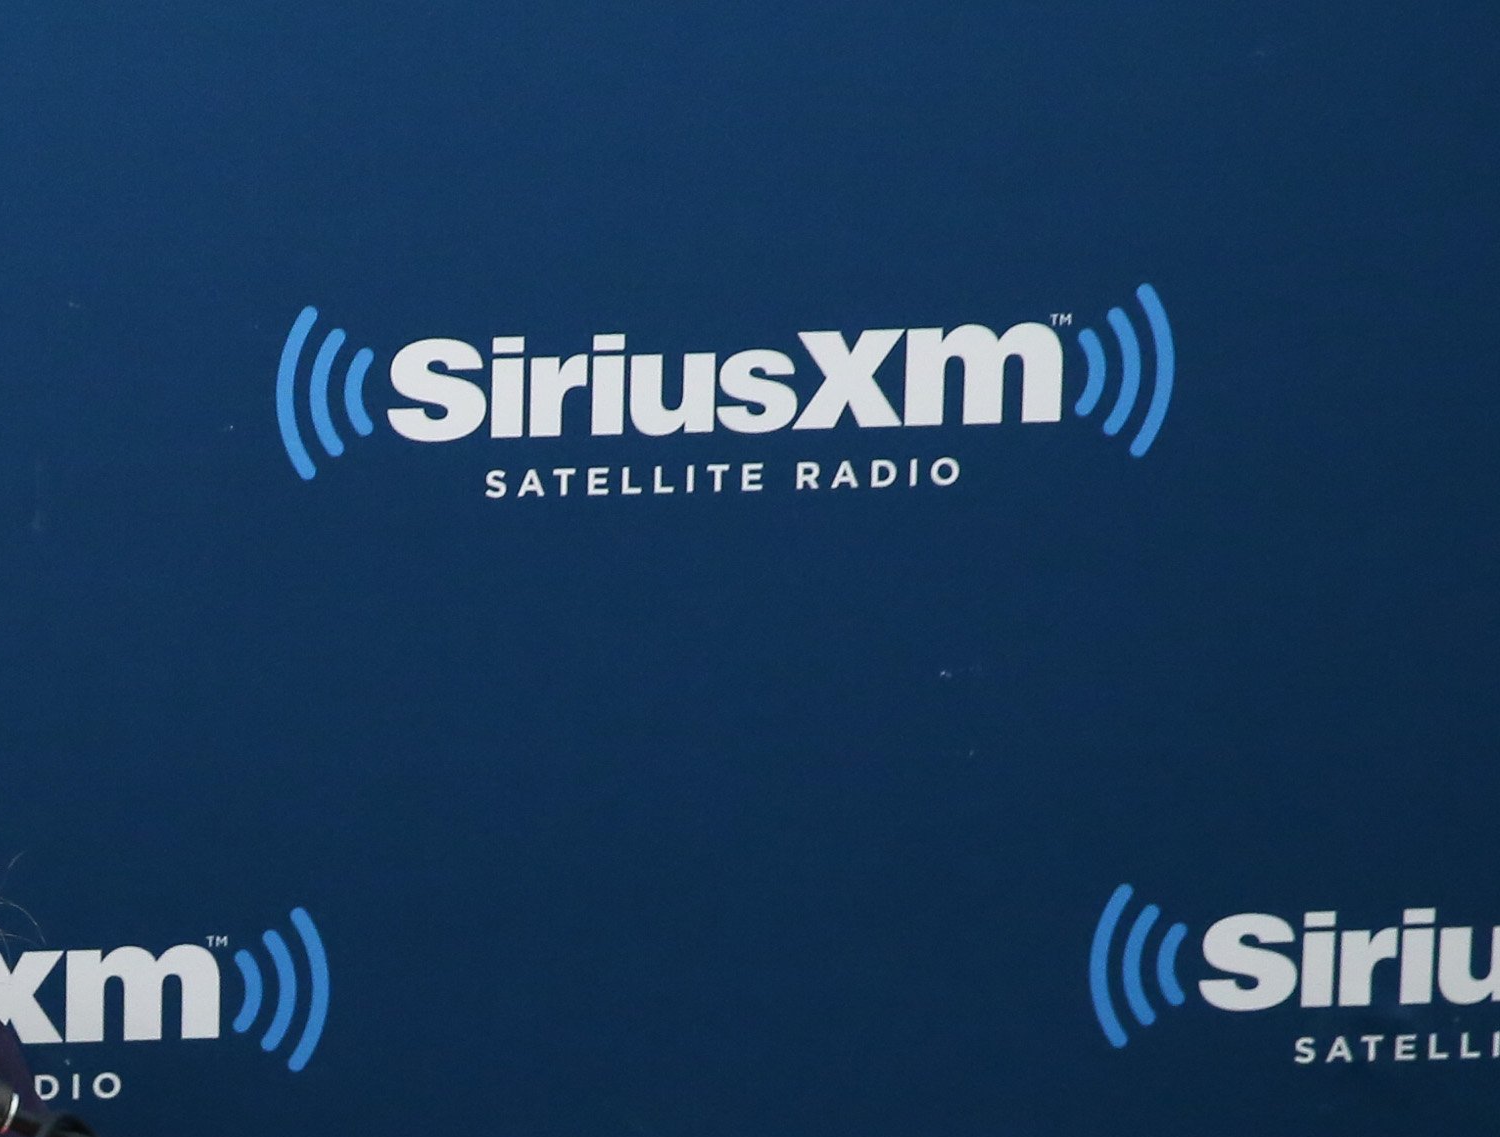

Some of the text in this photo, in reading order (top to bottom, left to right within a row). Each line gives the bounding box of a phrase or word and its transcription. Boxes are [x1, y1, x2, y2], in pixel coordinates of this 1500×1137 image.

[485, 457, 961, 499] SATELLITE RADIO
[34, 1072, 122, 1101] DIO
